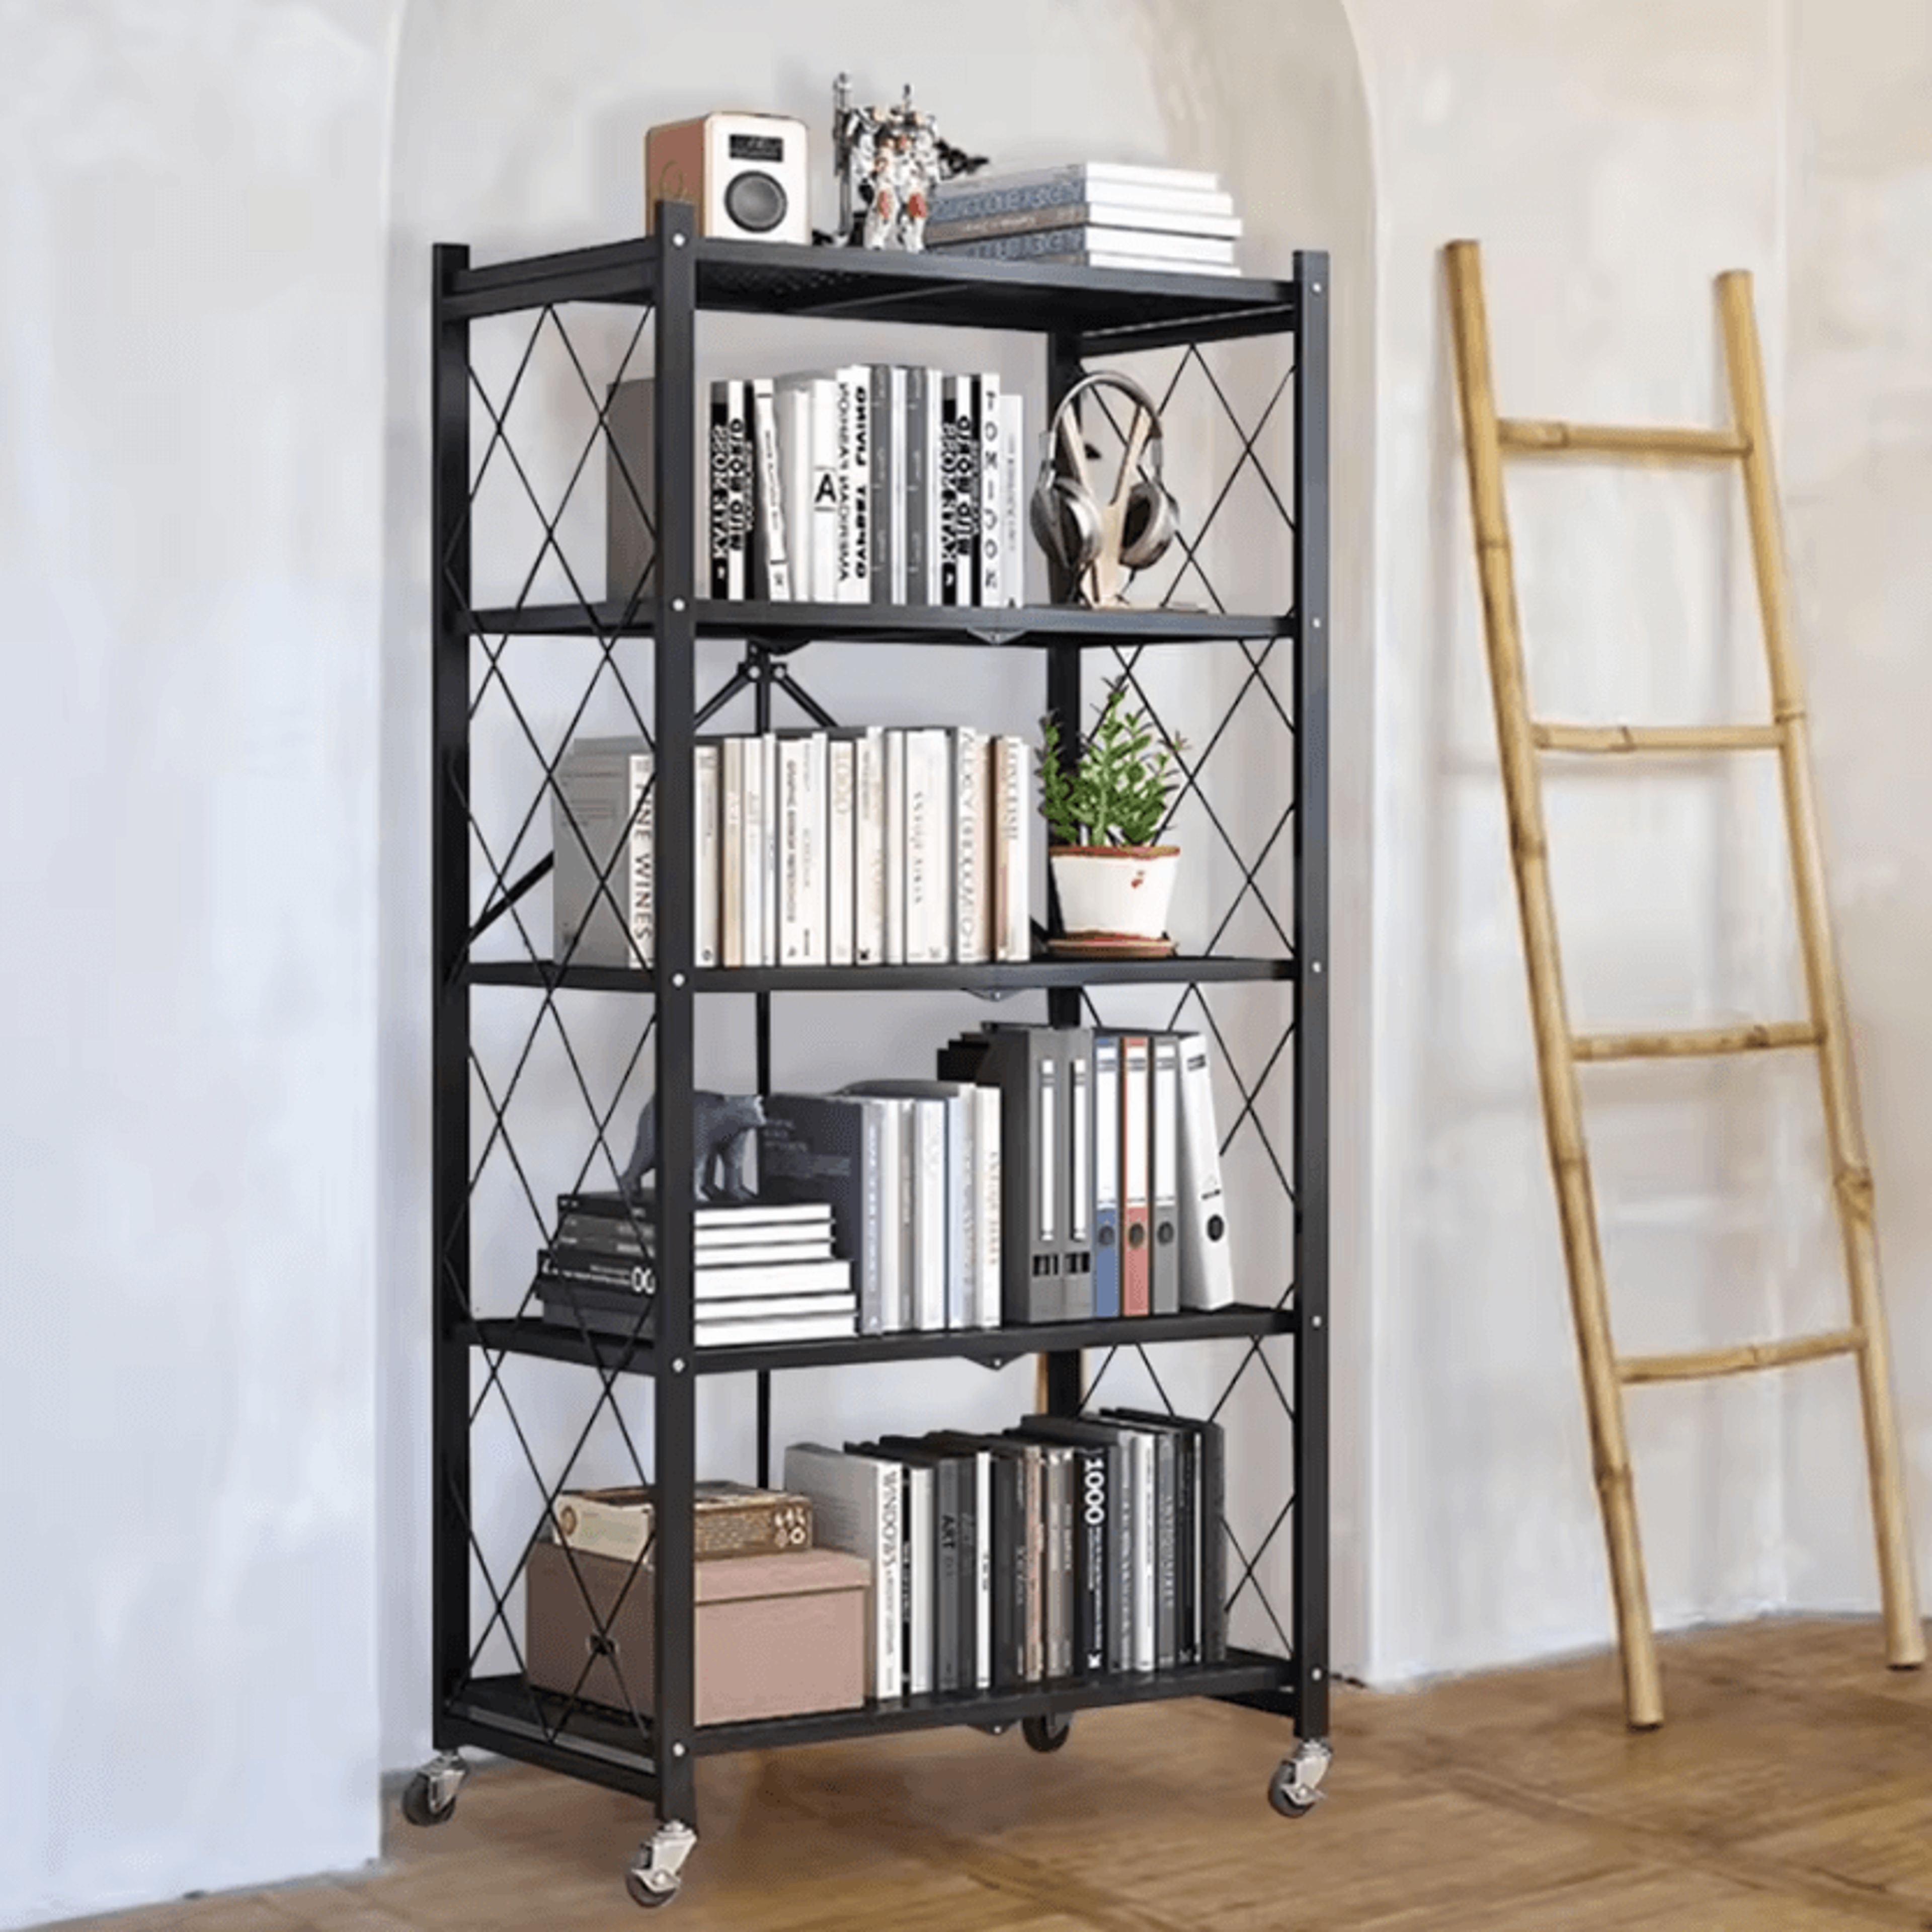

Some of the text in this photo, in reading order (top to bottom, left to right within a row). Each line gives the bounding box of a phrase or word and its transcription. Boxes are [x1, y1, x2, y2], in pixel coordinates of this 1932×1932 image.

[635, 853, 652, 940] WINES
[881, 1470, 897, 1567] WINDOWS
[1084, 1459, 1105, 1525] 1000
[942, 1515, 955, 1549] ART
